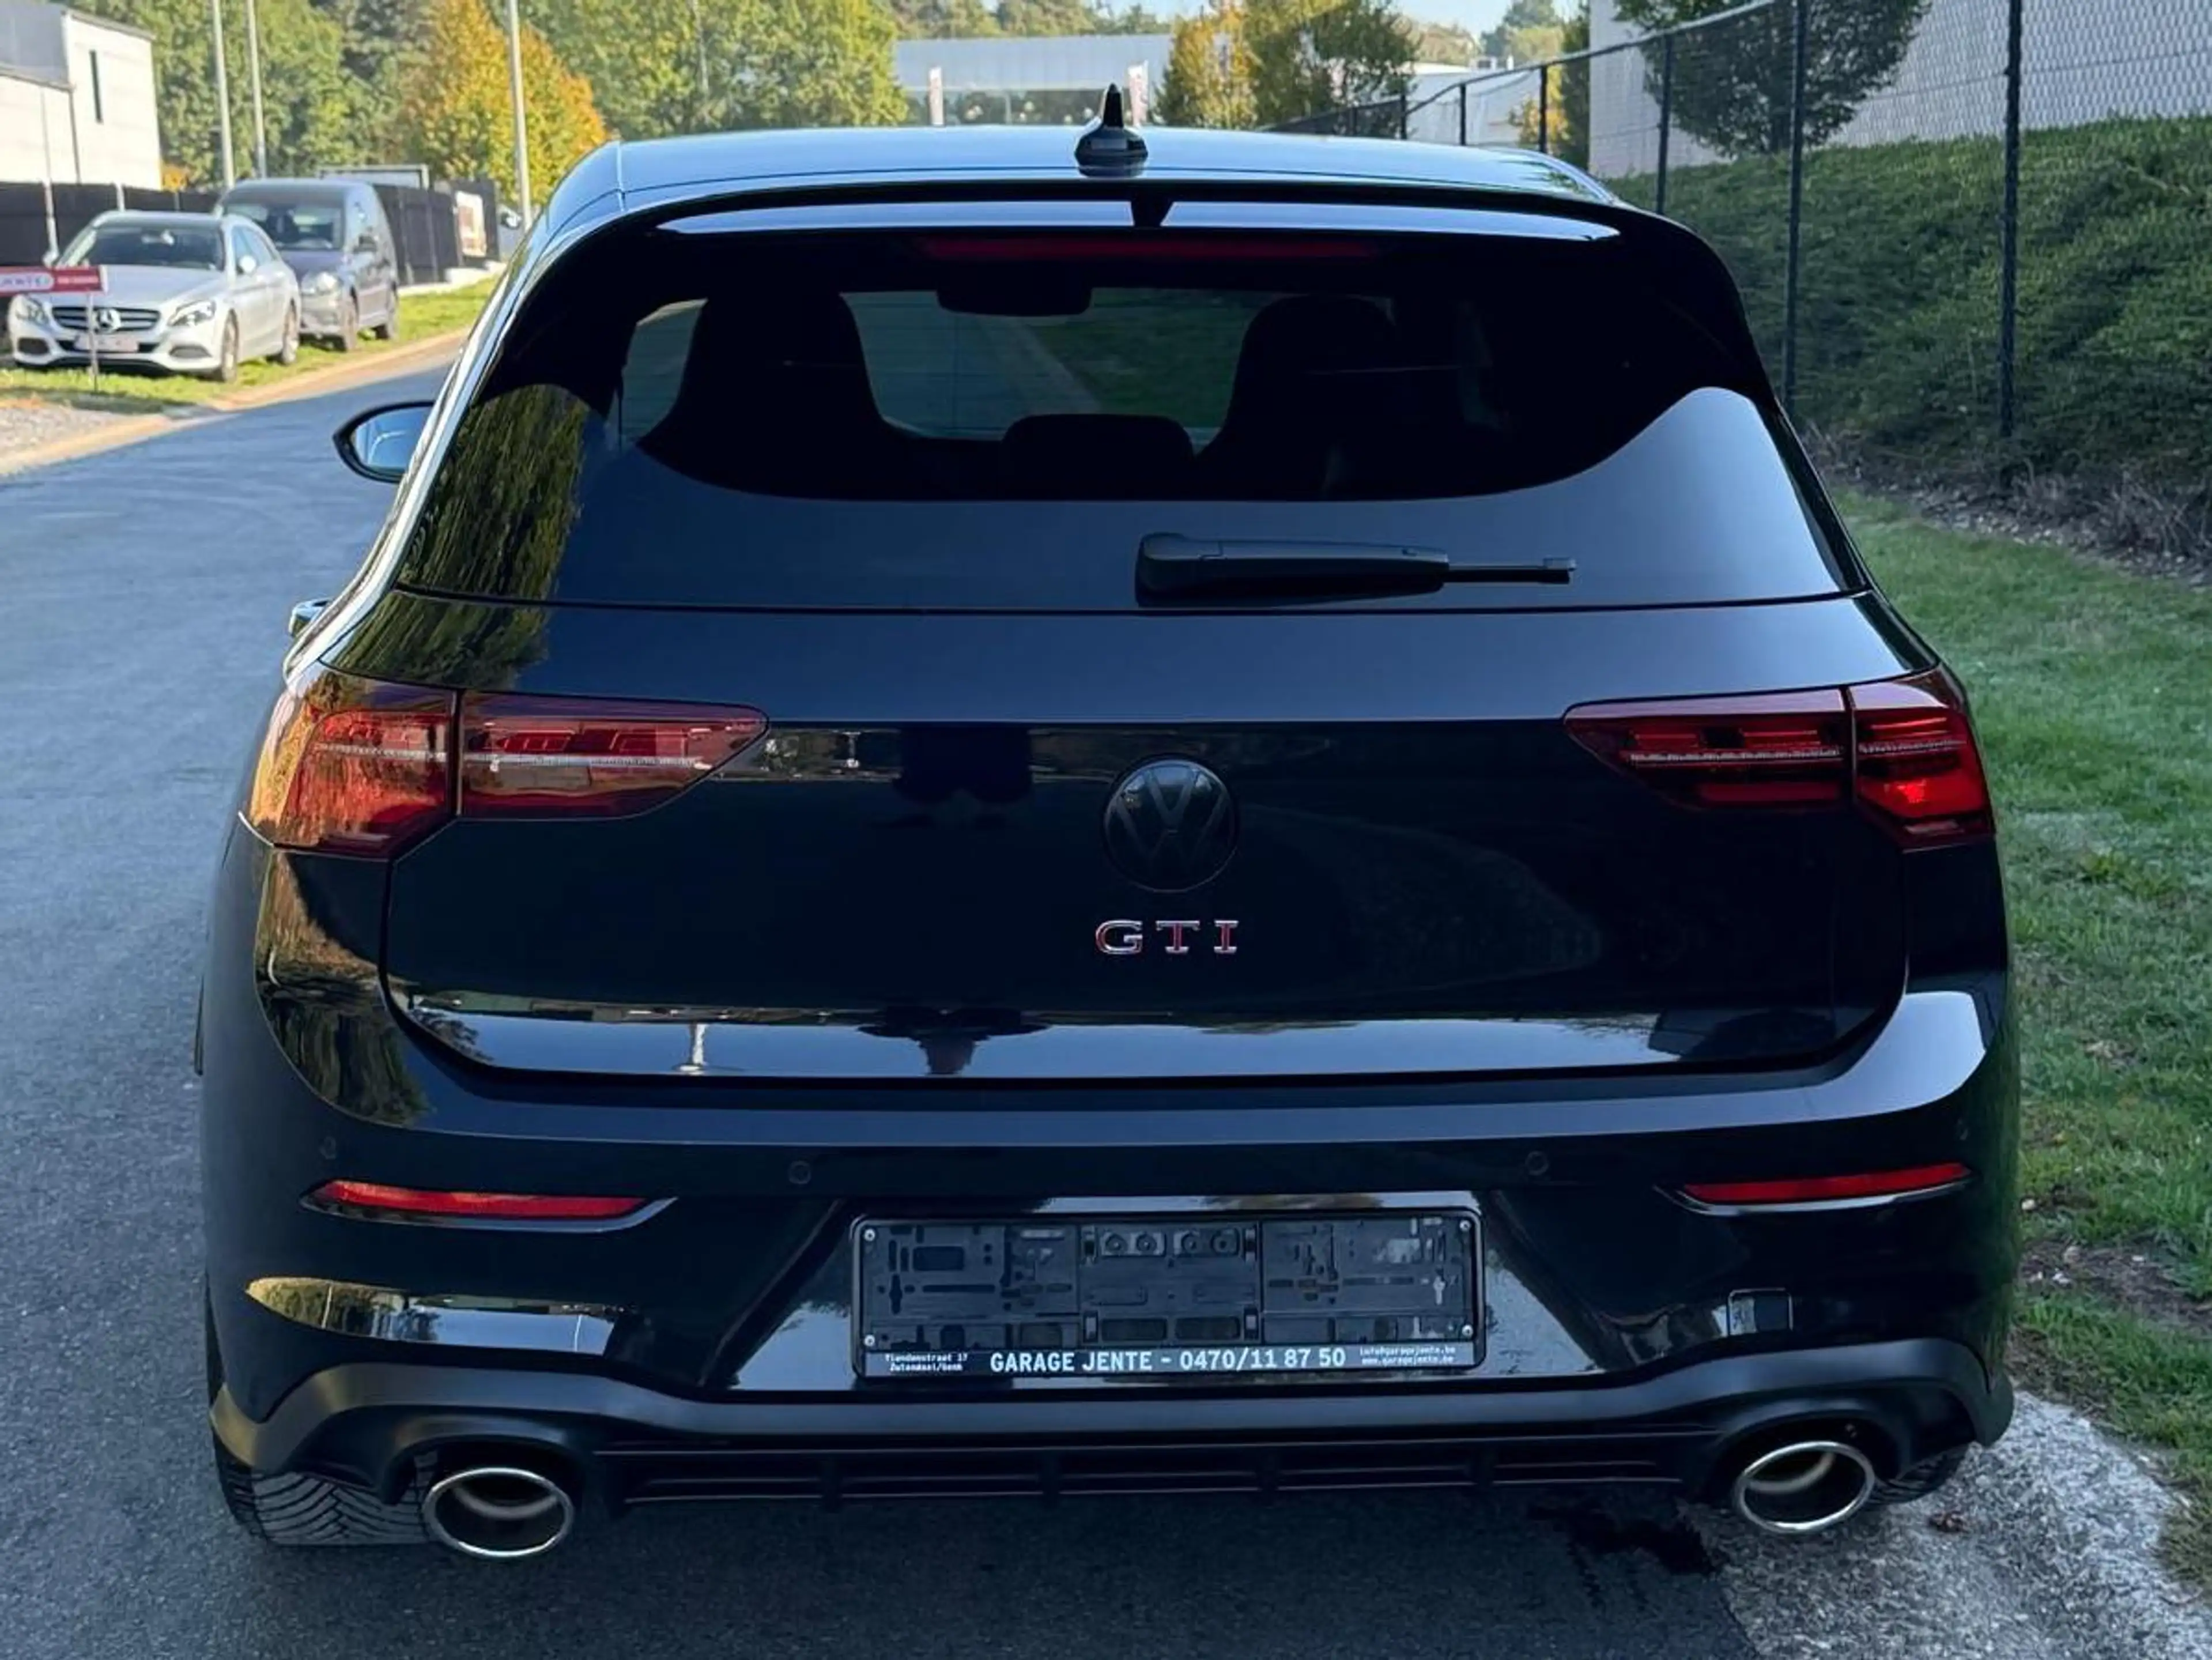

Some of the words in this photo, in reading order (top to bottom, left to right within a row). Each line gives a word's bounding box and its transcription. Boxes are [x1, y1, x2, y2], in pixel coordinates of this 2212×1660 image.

[1096, 919, 1239, 955] GTI
[990, 1352, 1075, 1372] GARAGE
[1082, 1351, 1152, 1371] JENTE
[1180, 1348, 1278, 1371] 0470/11
[1284, 1349, 1310, 1368] 87
[1319, 1348, 1346, 1368] 50
